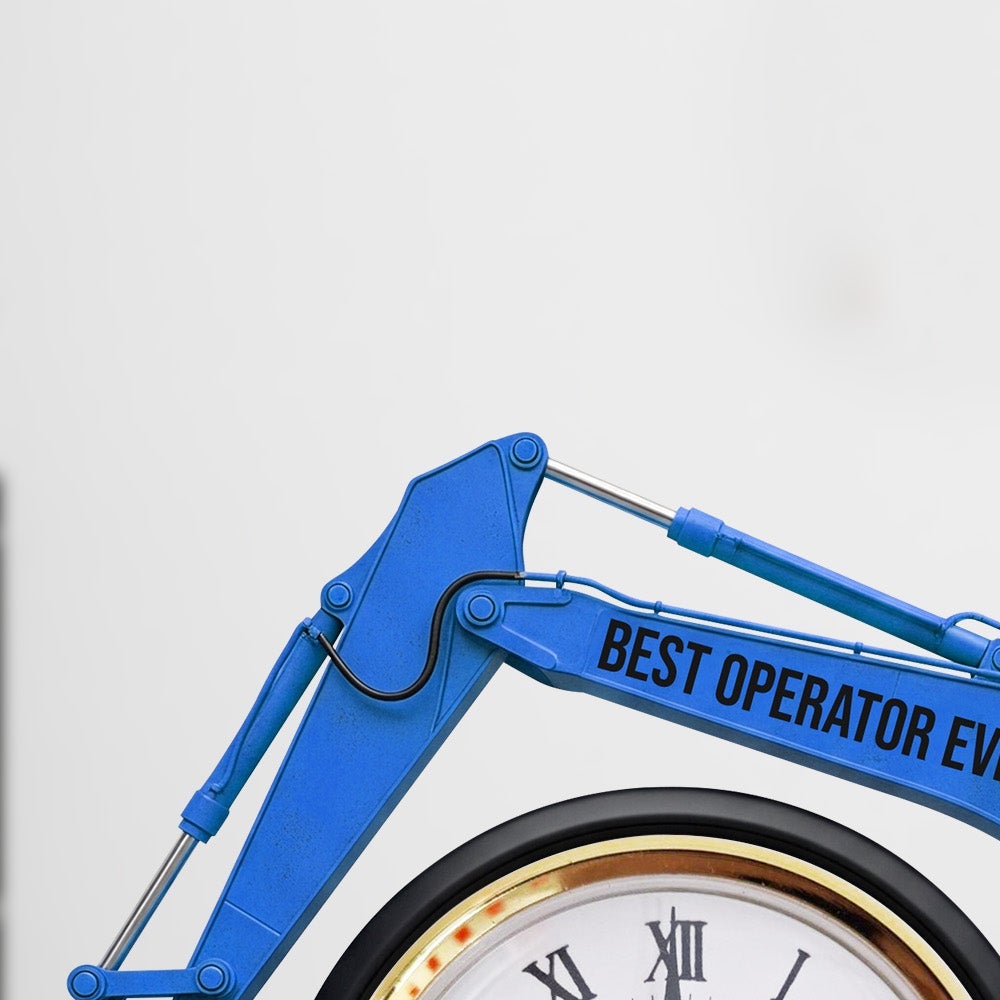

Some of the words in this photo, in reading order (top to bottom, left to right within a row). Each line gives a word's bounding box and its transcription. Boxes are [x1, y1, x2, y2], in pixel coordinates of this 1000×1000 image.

[597, 618, 712, 695] BEST
[715, 653, 936, 761] OPERATOR
[644, 920, 707, 982] XII
